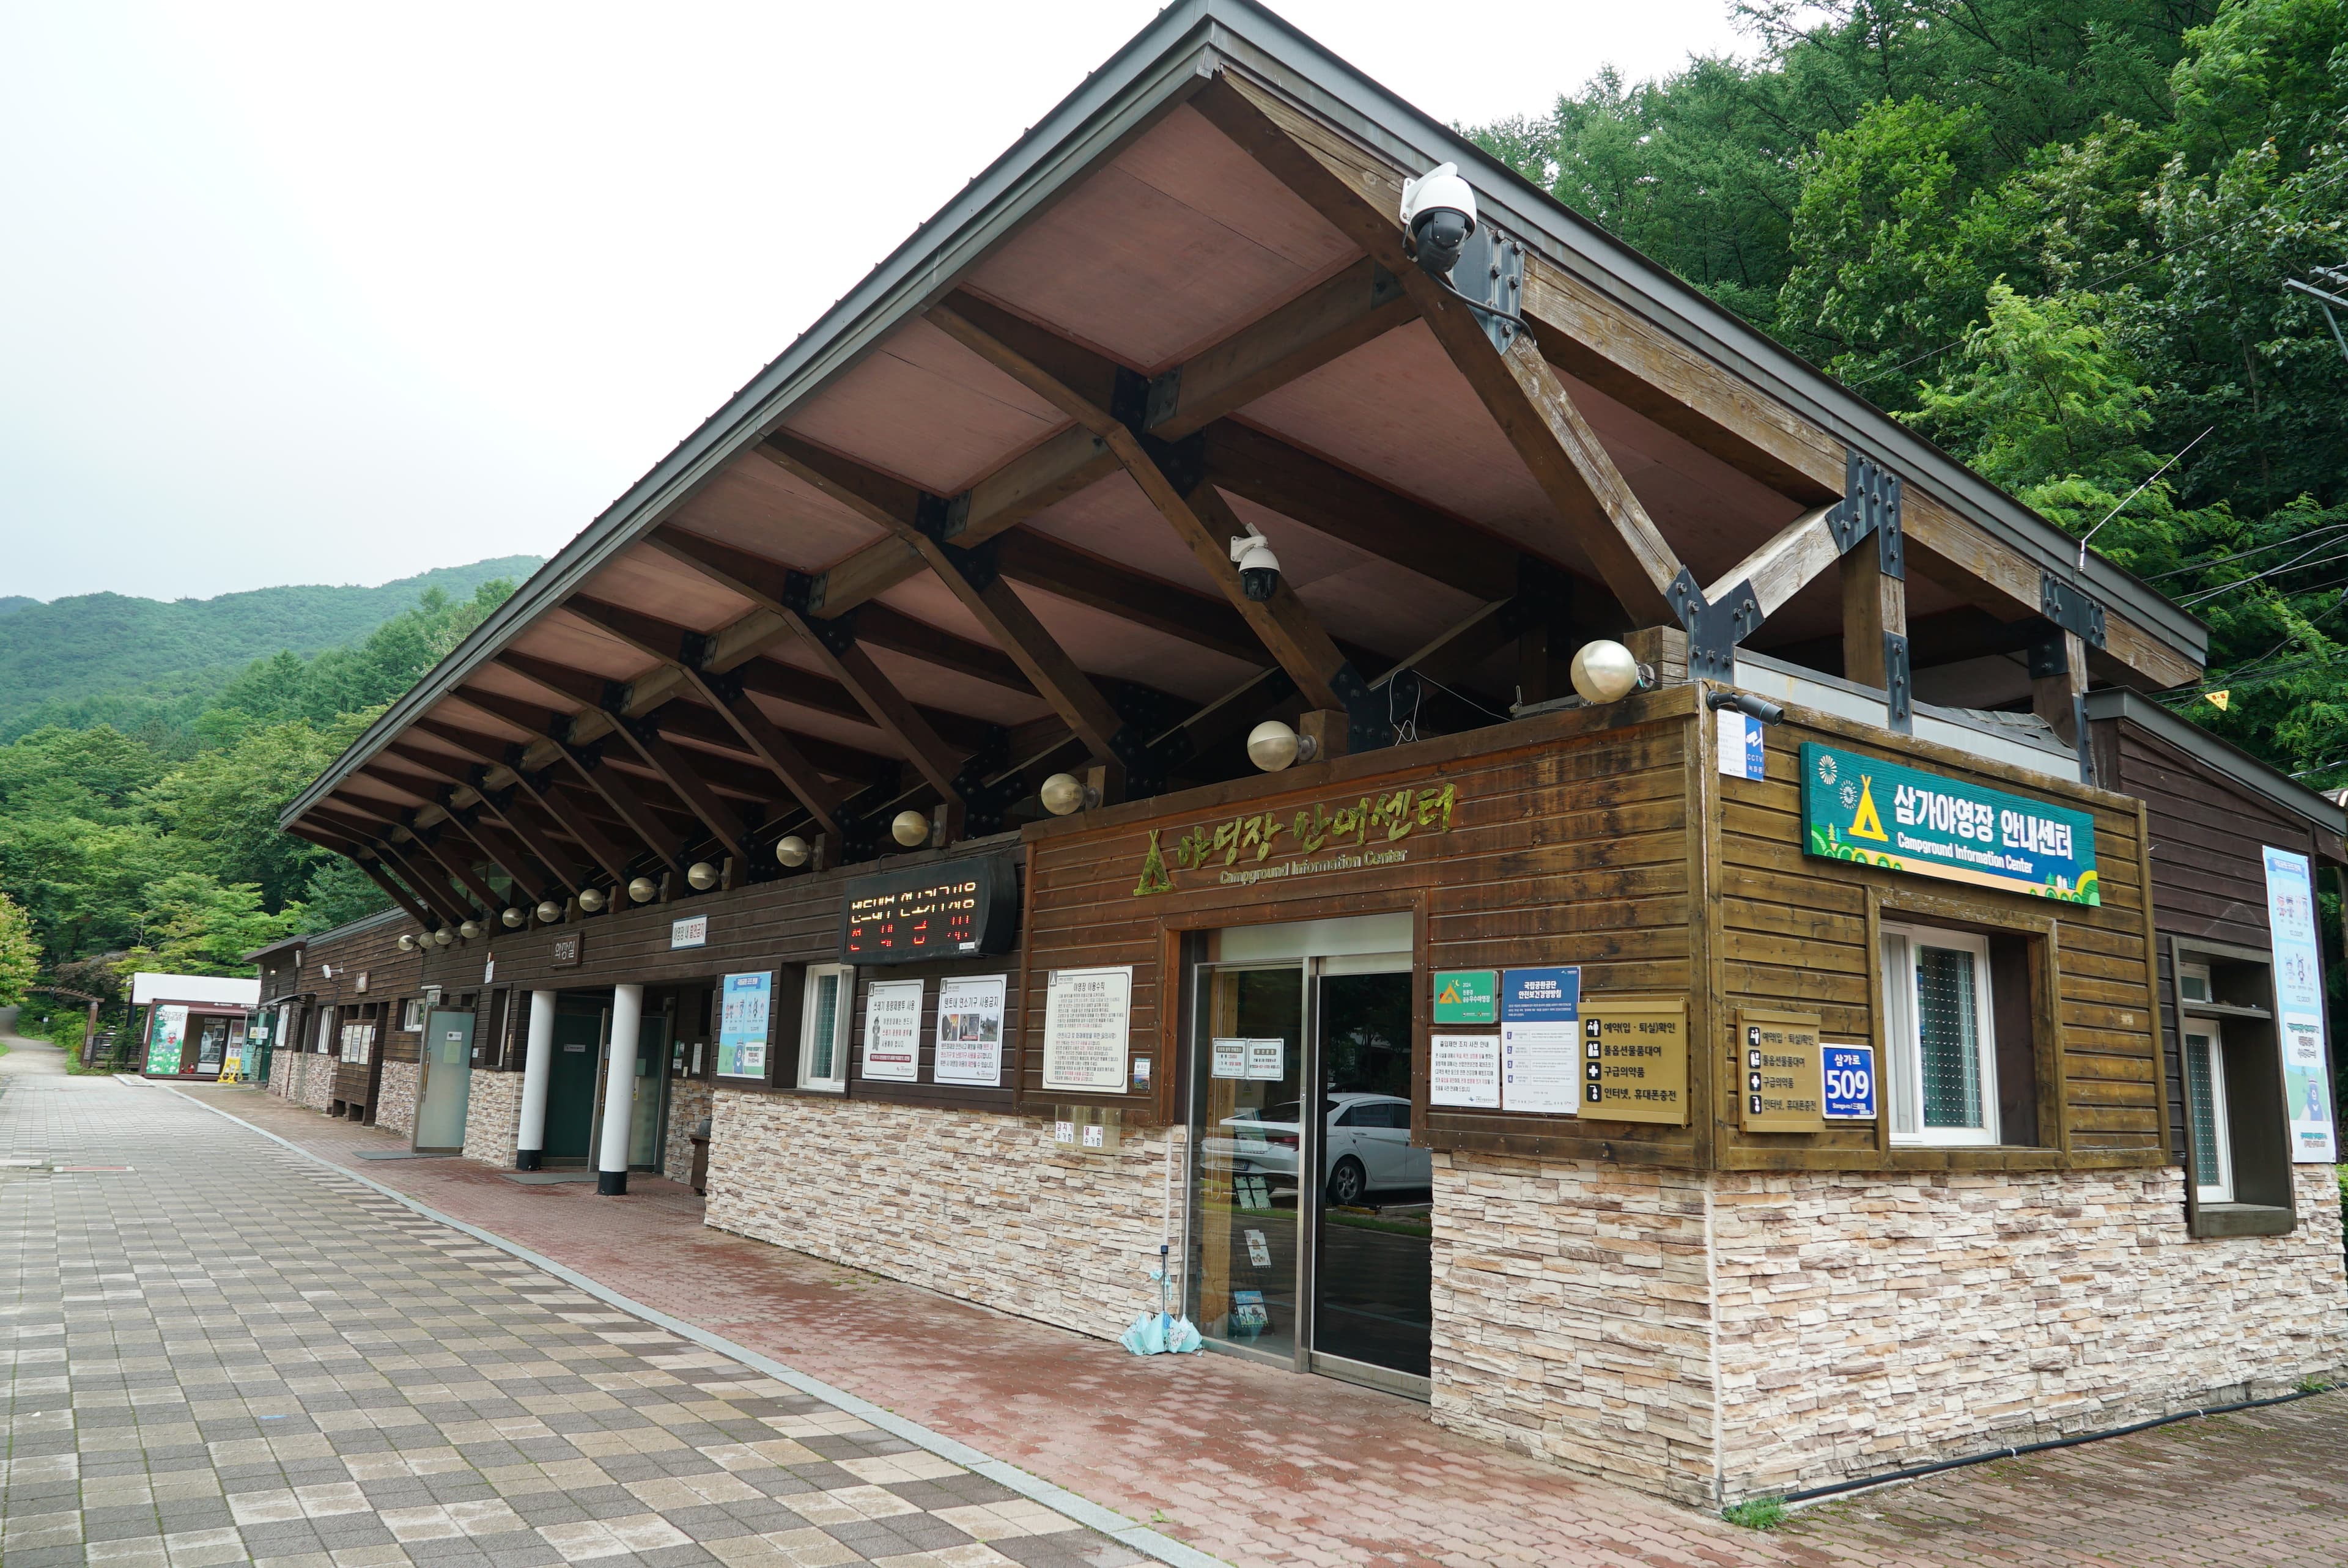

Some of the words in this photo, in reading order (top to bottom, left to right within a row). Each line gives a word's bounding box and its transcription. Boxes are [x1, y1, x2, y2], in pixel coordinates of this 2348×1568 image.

[1747, 754, 1762, 762] CCTV
[1178, 812, 1283, 869] 야영장
[1293, 782, 1458, 853] 안내센터
[1894, 784, 1993, 842] 삼가야영장
[2000, 810, 2073, 859] 안내센터
[1897, 831, 1952, 859] Campground
[1955, 844, 2004, 868] Information
[2006, 855, 2033, 874] Center
[1219, 861, 1288, 885] Campground
[1291, 853, 1360, 876] Information
[1364, 850, 1408, 866] Center
[555, 940, 575, 960] 화장실
[1524, 981, 1557, 990] 국립공원공단
[907, 999, 915, 1011] 사용
[959, 997, 978, 1008] 연소기구
[980, 996, 999, 1007] 사용금지
[1604, 1045, 1661, 1056] 풀옵션물품대여
[1834, 1054, 1861, 1067] 삼가로
[1604, 1066, 1645, 1078] 구급의약품
[1763, 1077, 1794, 1089] 구급의약품
[1826, 1070, 1869, 1099] 509
[1634, 1089, 1677, 1101] 휴대폰충전
